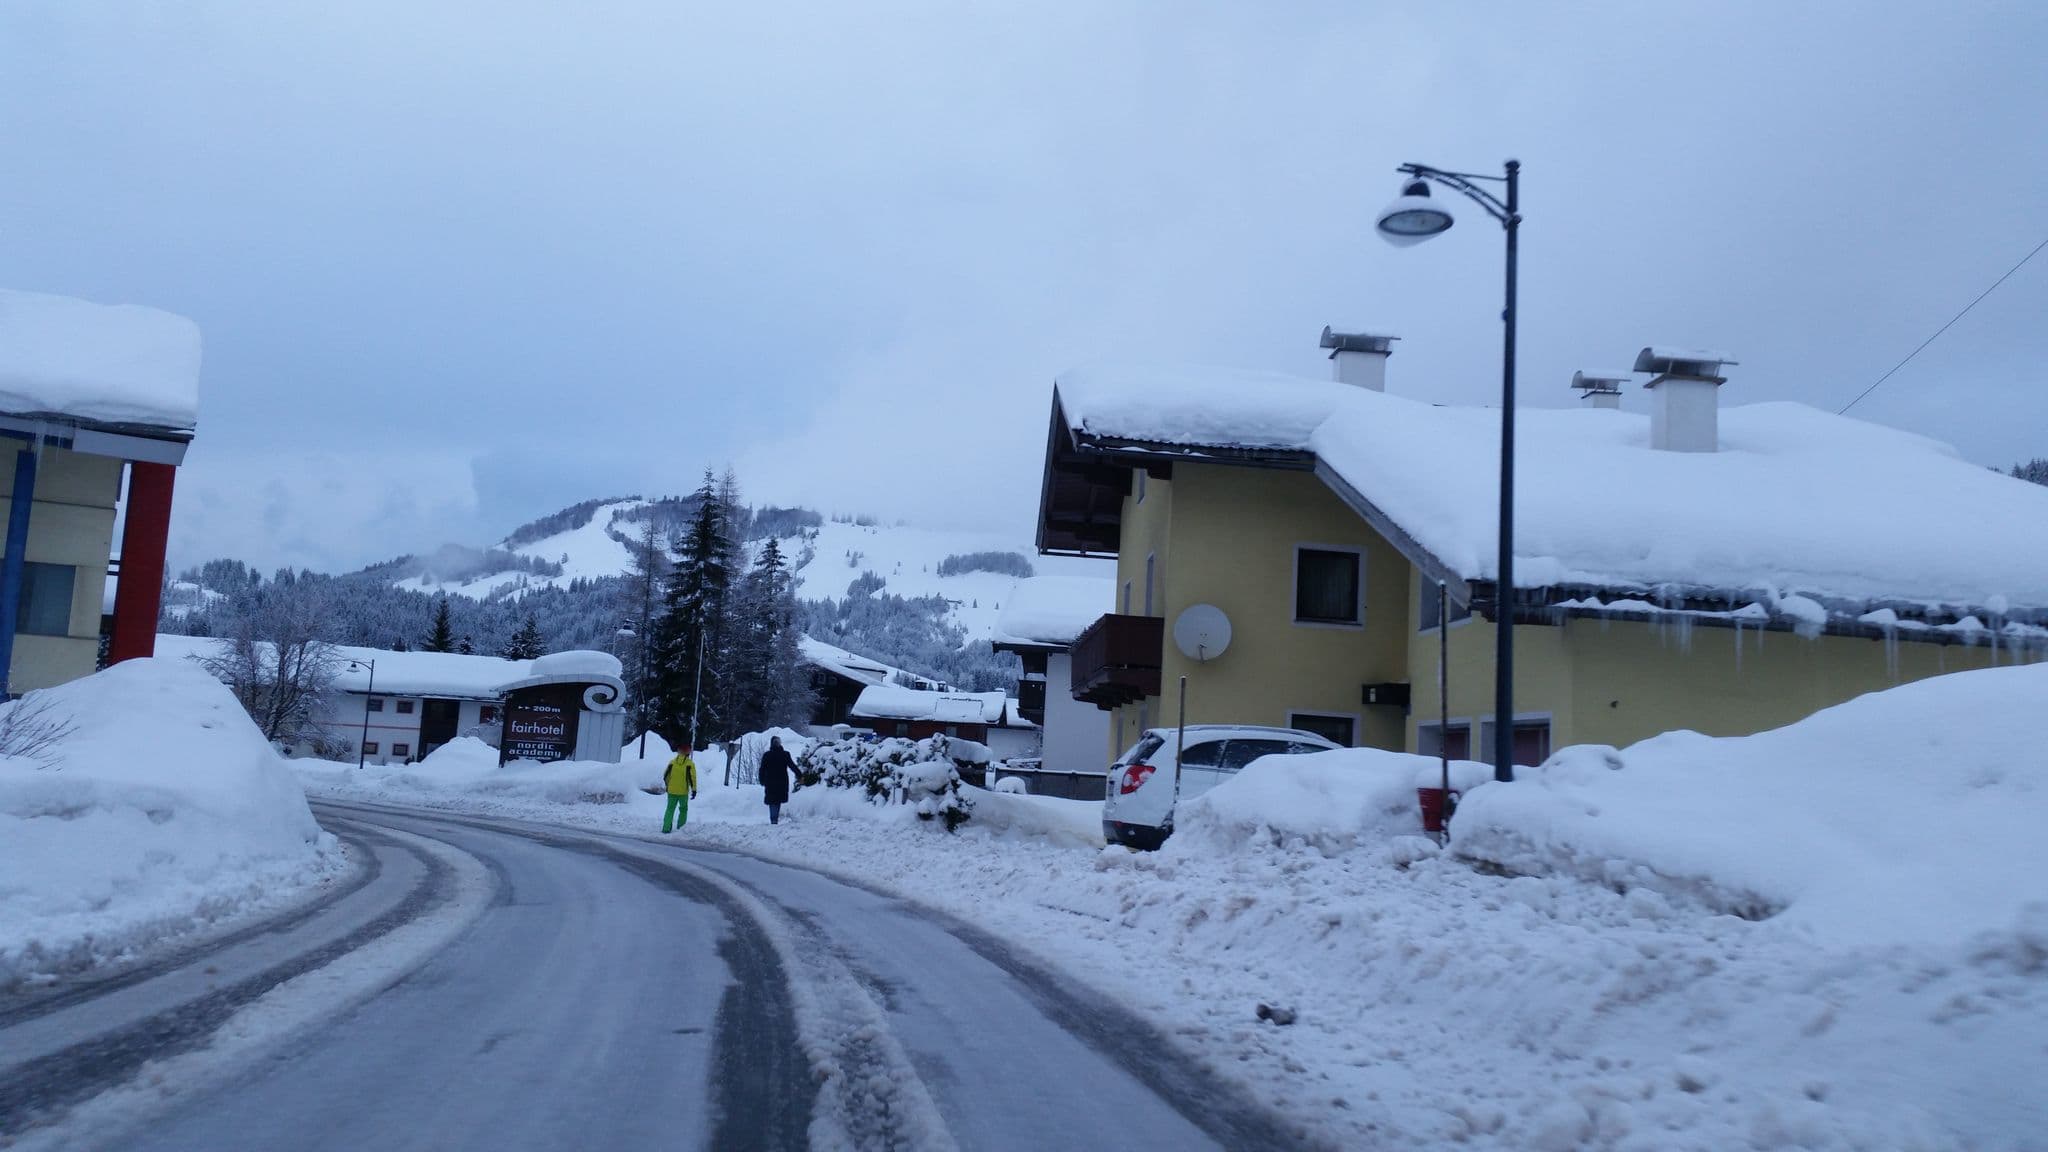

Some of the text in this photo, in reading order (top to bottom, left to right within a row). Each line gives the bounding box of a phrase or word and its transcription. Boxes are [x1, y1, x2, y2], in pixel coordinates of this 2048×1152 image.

[512, 720, 564, 735] fairhotel
[517, 742, 555, 750] nordic
[509, 749, 561, 758] academy
